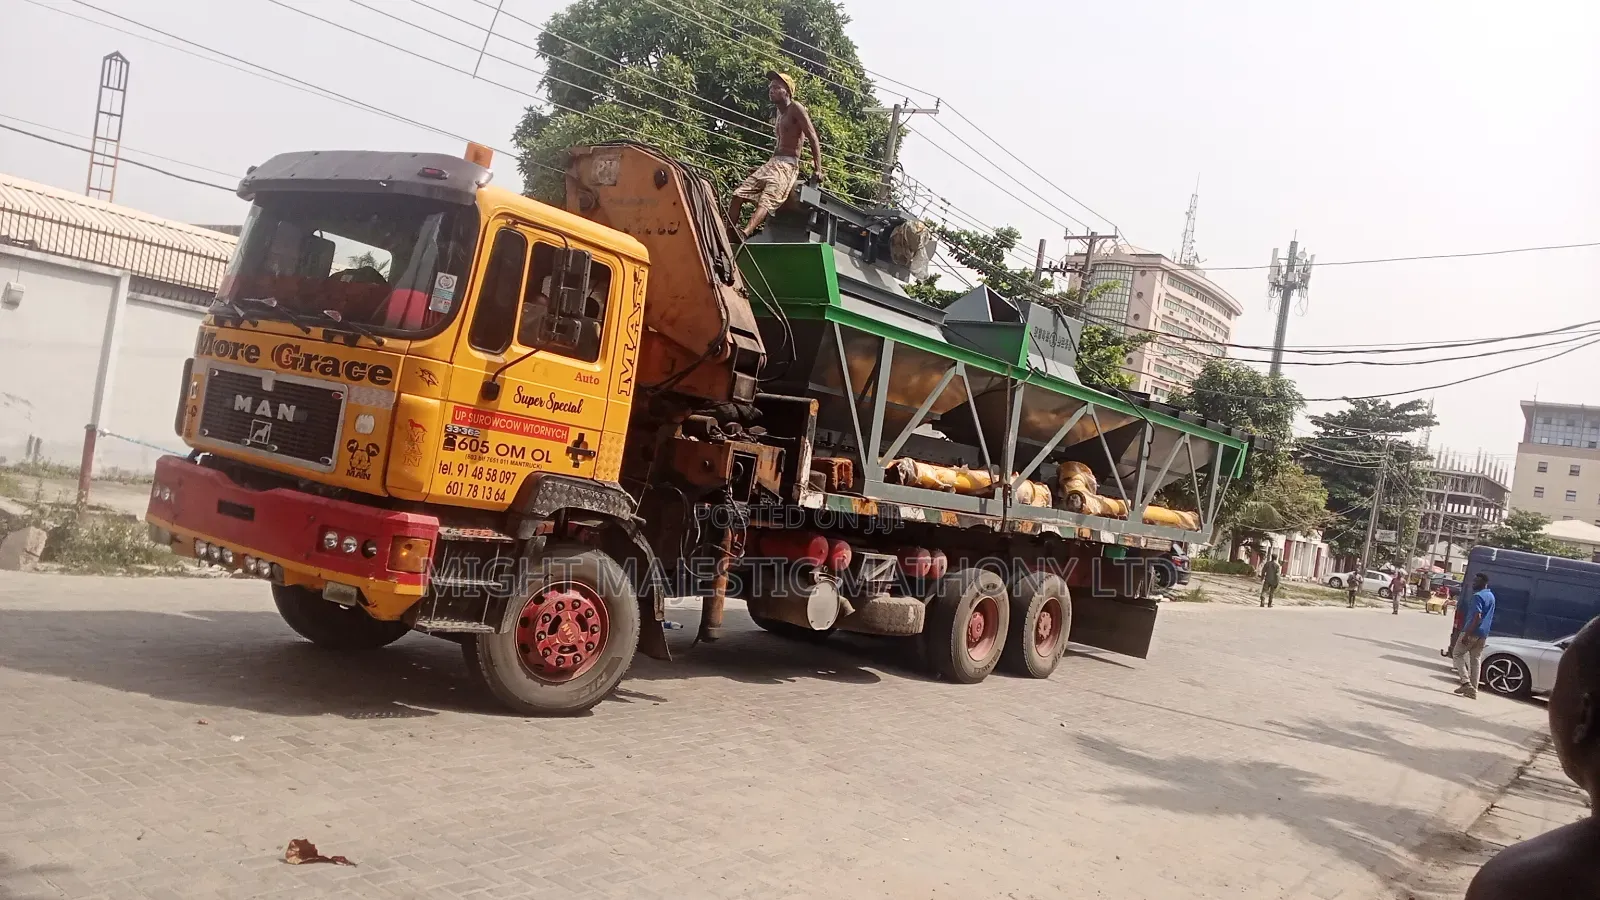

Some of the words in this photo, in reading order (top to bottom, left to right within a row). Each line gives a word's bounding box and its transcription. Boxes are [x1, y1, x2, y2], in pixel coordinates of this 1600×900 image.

[197, 331, 260, 364] More
[271, 343, 393, 385] Grace
[574, 371, 600, 386] Auto
[234, 394, 297, 422] MAN
[513, 385, 545, 408] Super
[545, 391, 584, 415] Special
[454, 410, 467, 422] UP
[468, 412, 522, 432] SUROWCOW
[522, 423, 568, 440] WTORNYCH
[457, 438, 490, 454] 605
[495, 443, 526, 460] OM
[531, 448, 552, 463] OL
[438, 460, 453, 476] tel.
[457, 463, 468, 478] 91
[471, 466, 483, 481] 48
[485, 467, 498, 483] 58
[500, 470, 517, 485] 097
[446, 480, 464, 496] 601
[466, 484, 479, 499] 78
[481, 485, 492, 501] 13
[494, 487, 507, 502] 64
